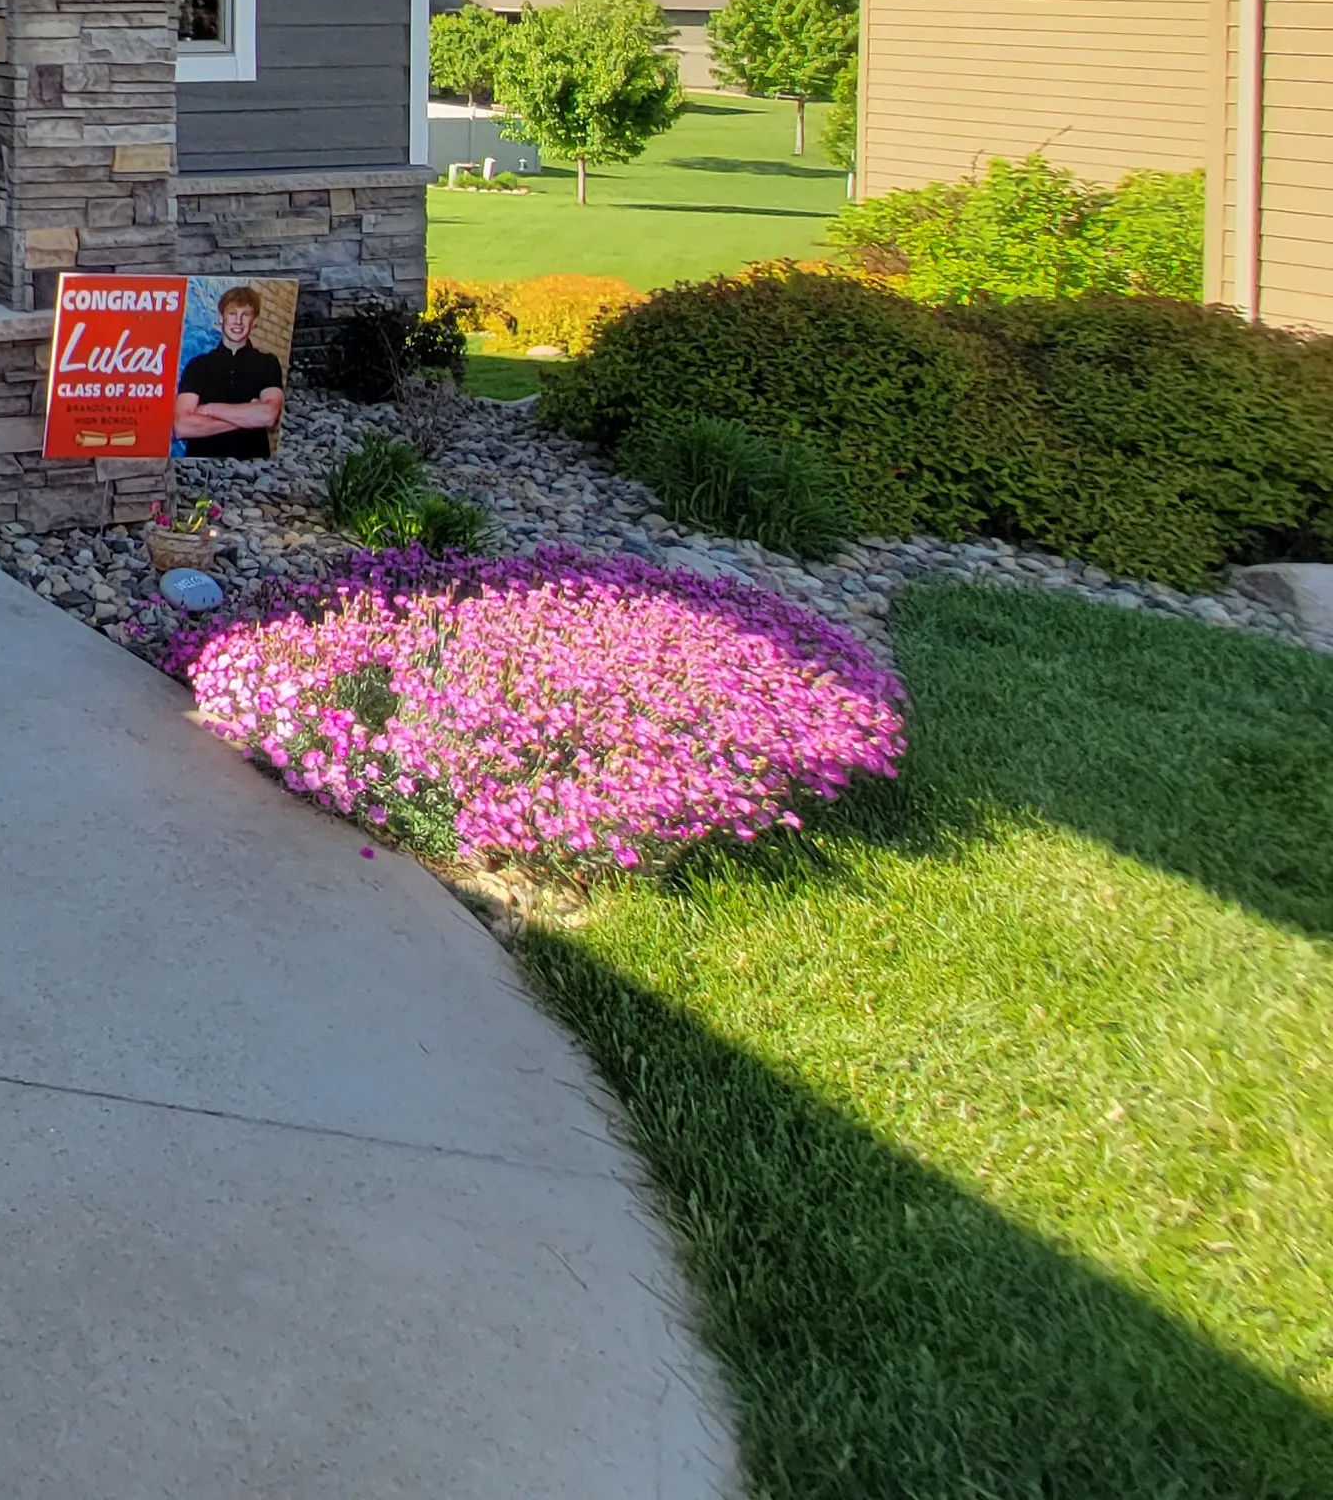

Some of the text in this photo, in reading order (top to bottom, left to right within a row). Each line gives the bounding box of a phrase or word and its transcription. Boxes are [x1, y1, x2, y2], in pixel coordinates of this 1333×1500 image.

[62, 289, 180, 312] CONGRATS
[59, 321, 167, 376] Lukas
[57, 383, 164, 398] CLASS OF 2024
